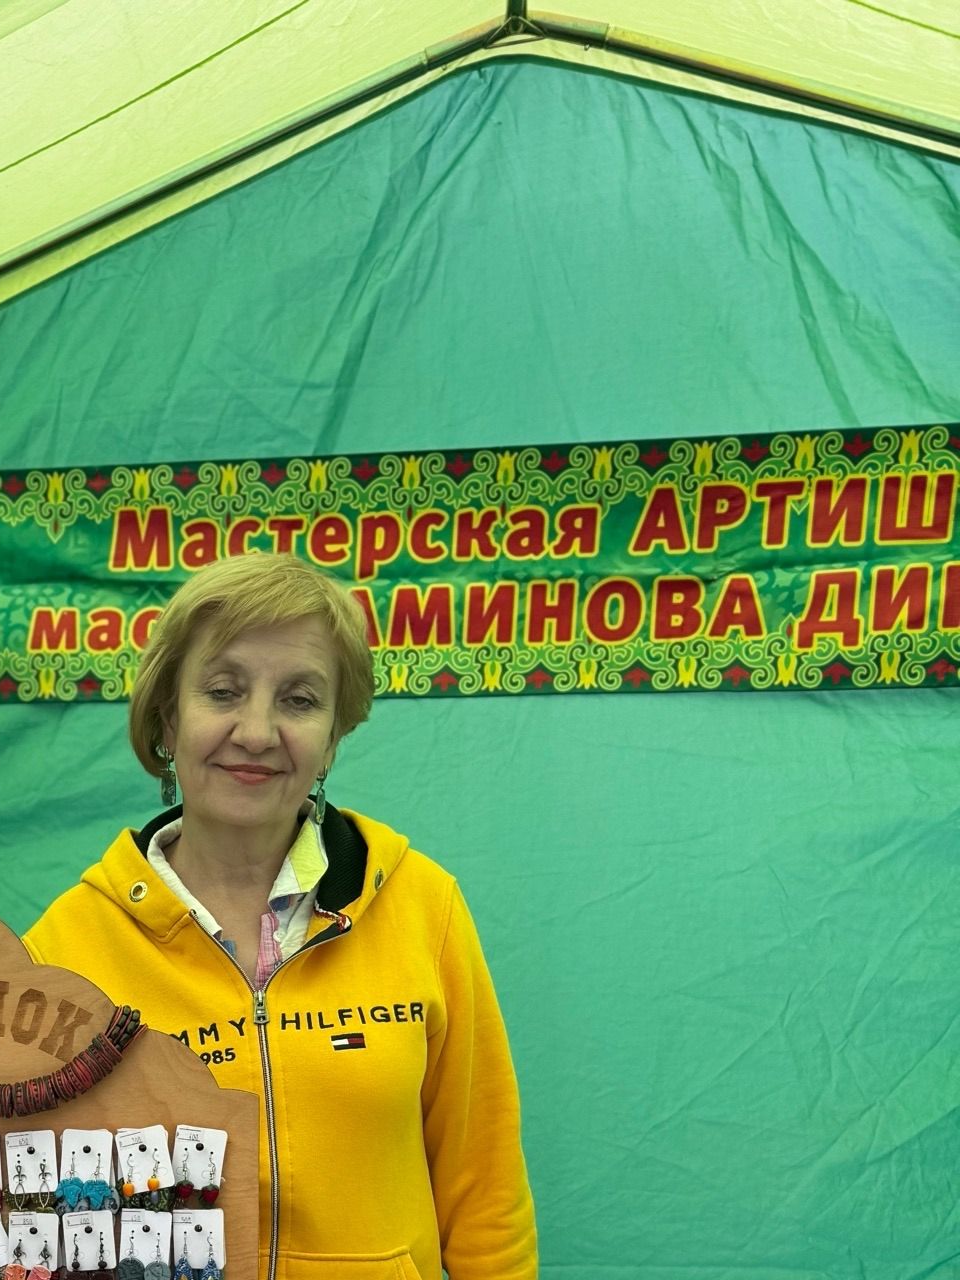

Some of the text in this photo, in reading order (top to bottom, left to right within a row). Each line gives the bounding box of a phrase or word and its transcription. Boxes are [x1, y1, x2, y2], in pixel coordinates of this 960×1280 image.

[110, 472, 957, 580] Мастерская АРТИШ
[169, 1002, 424, 1046] MMY HILFIGER
[200, 1047, 236, 1065] 985
